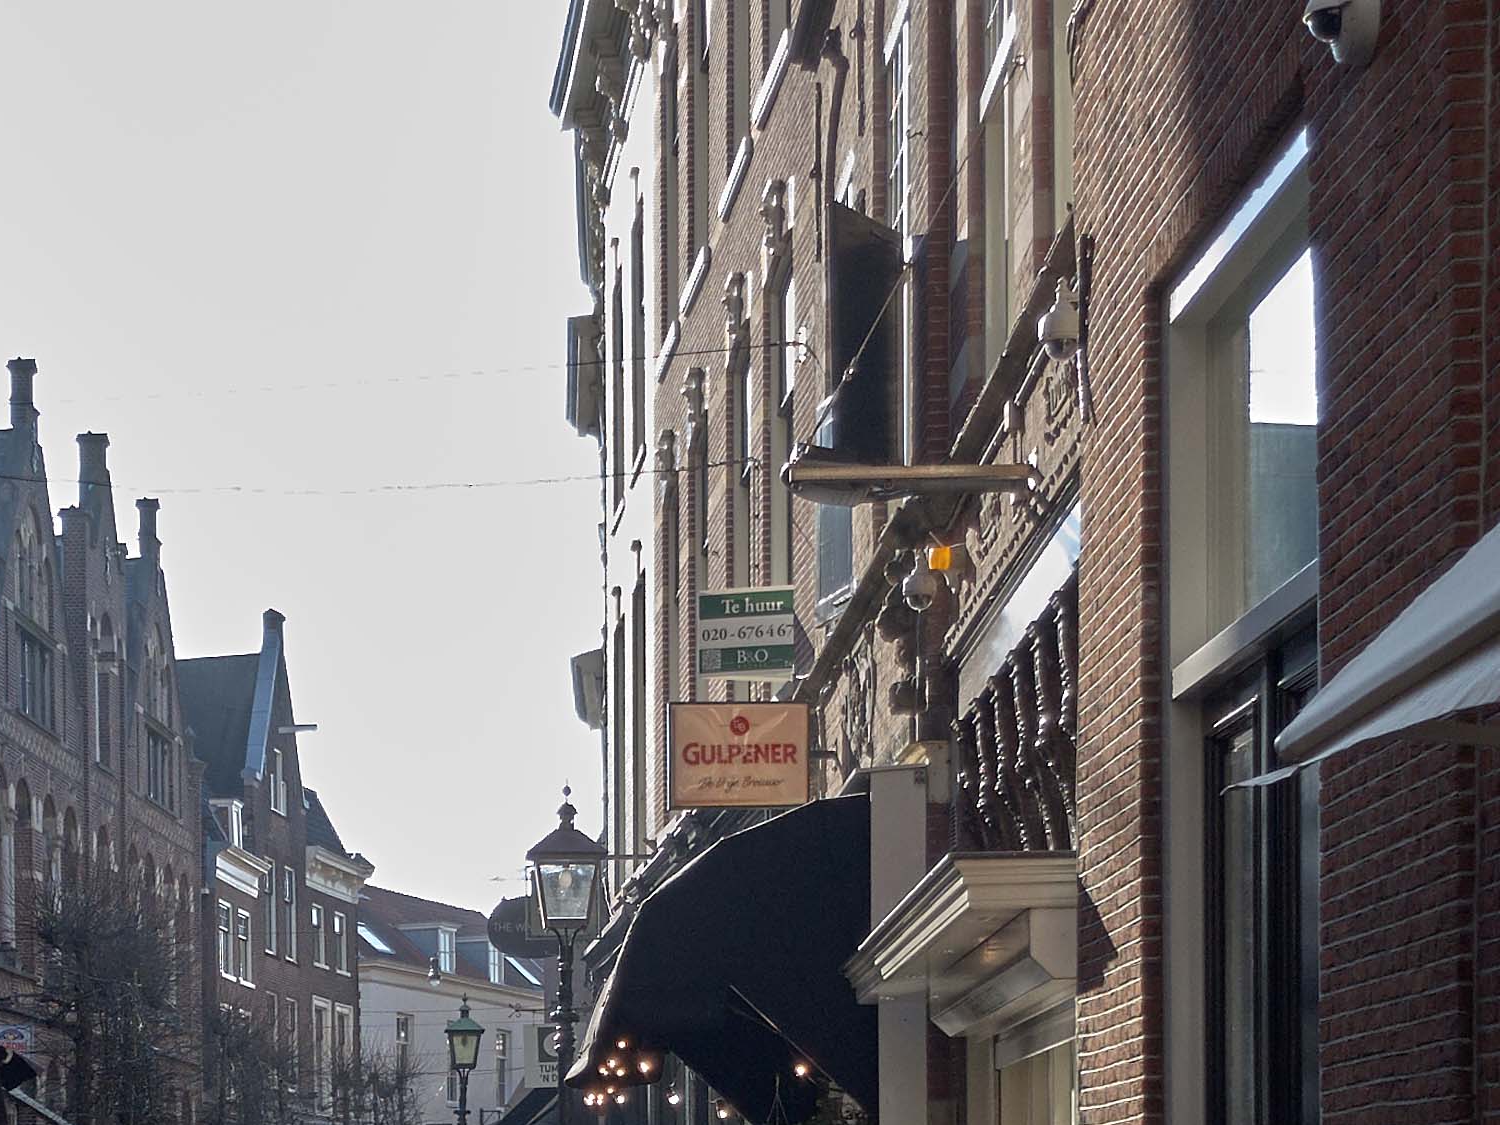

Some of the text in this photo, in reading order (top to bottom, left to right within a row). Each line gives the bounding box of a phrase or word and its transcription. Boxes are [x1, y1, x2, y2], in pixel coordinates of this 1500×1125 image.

[721, 596, 785, 615] Te huur
[681, 741, 798, 766] GULPENER
[540, 1064, 558, 1073] TUM
